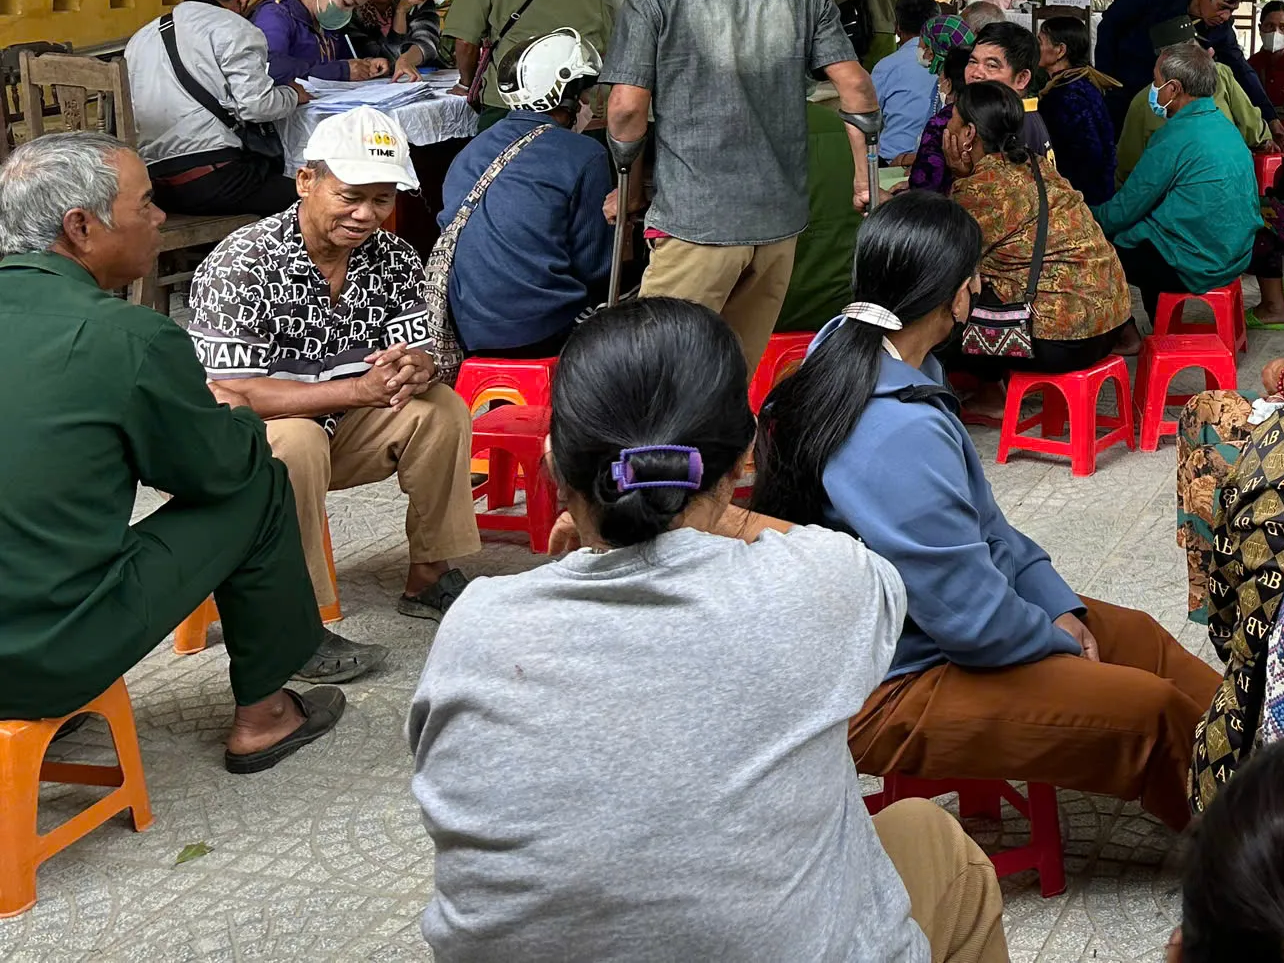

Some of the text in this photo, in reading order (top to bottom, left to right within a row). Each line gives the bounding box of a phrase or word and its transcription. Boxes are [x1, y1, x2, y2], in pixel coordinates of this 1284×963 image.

[368, 148, 396, 157] TIME
[191, 337, 253, 368] STIAN
[1259, 429, 1280, 449] AB
[1209, 576, 1230, 598] AB
[1257, 569, 1282, 590] AB
[1246, 616, 1270, 639] AB
[1215, 764, 1236, 783] A
